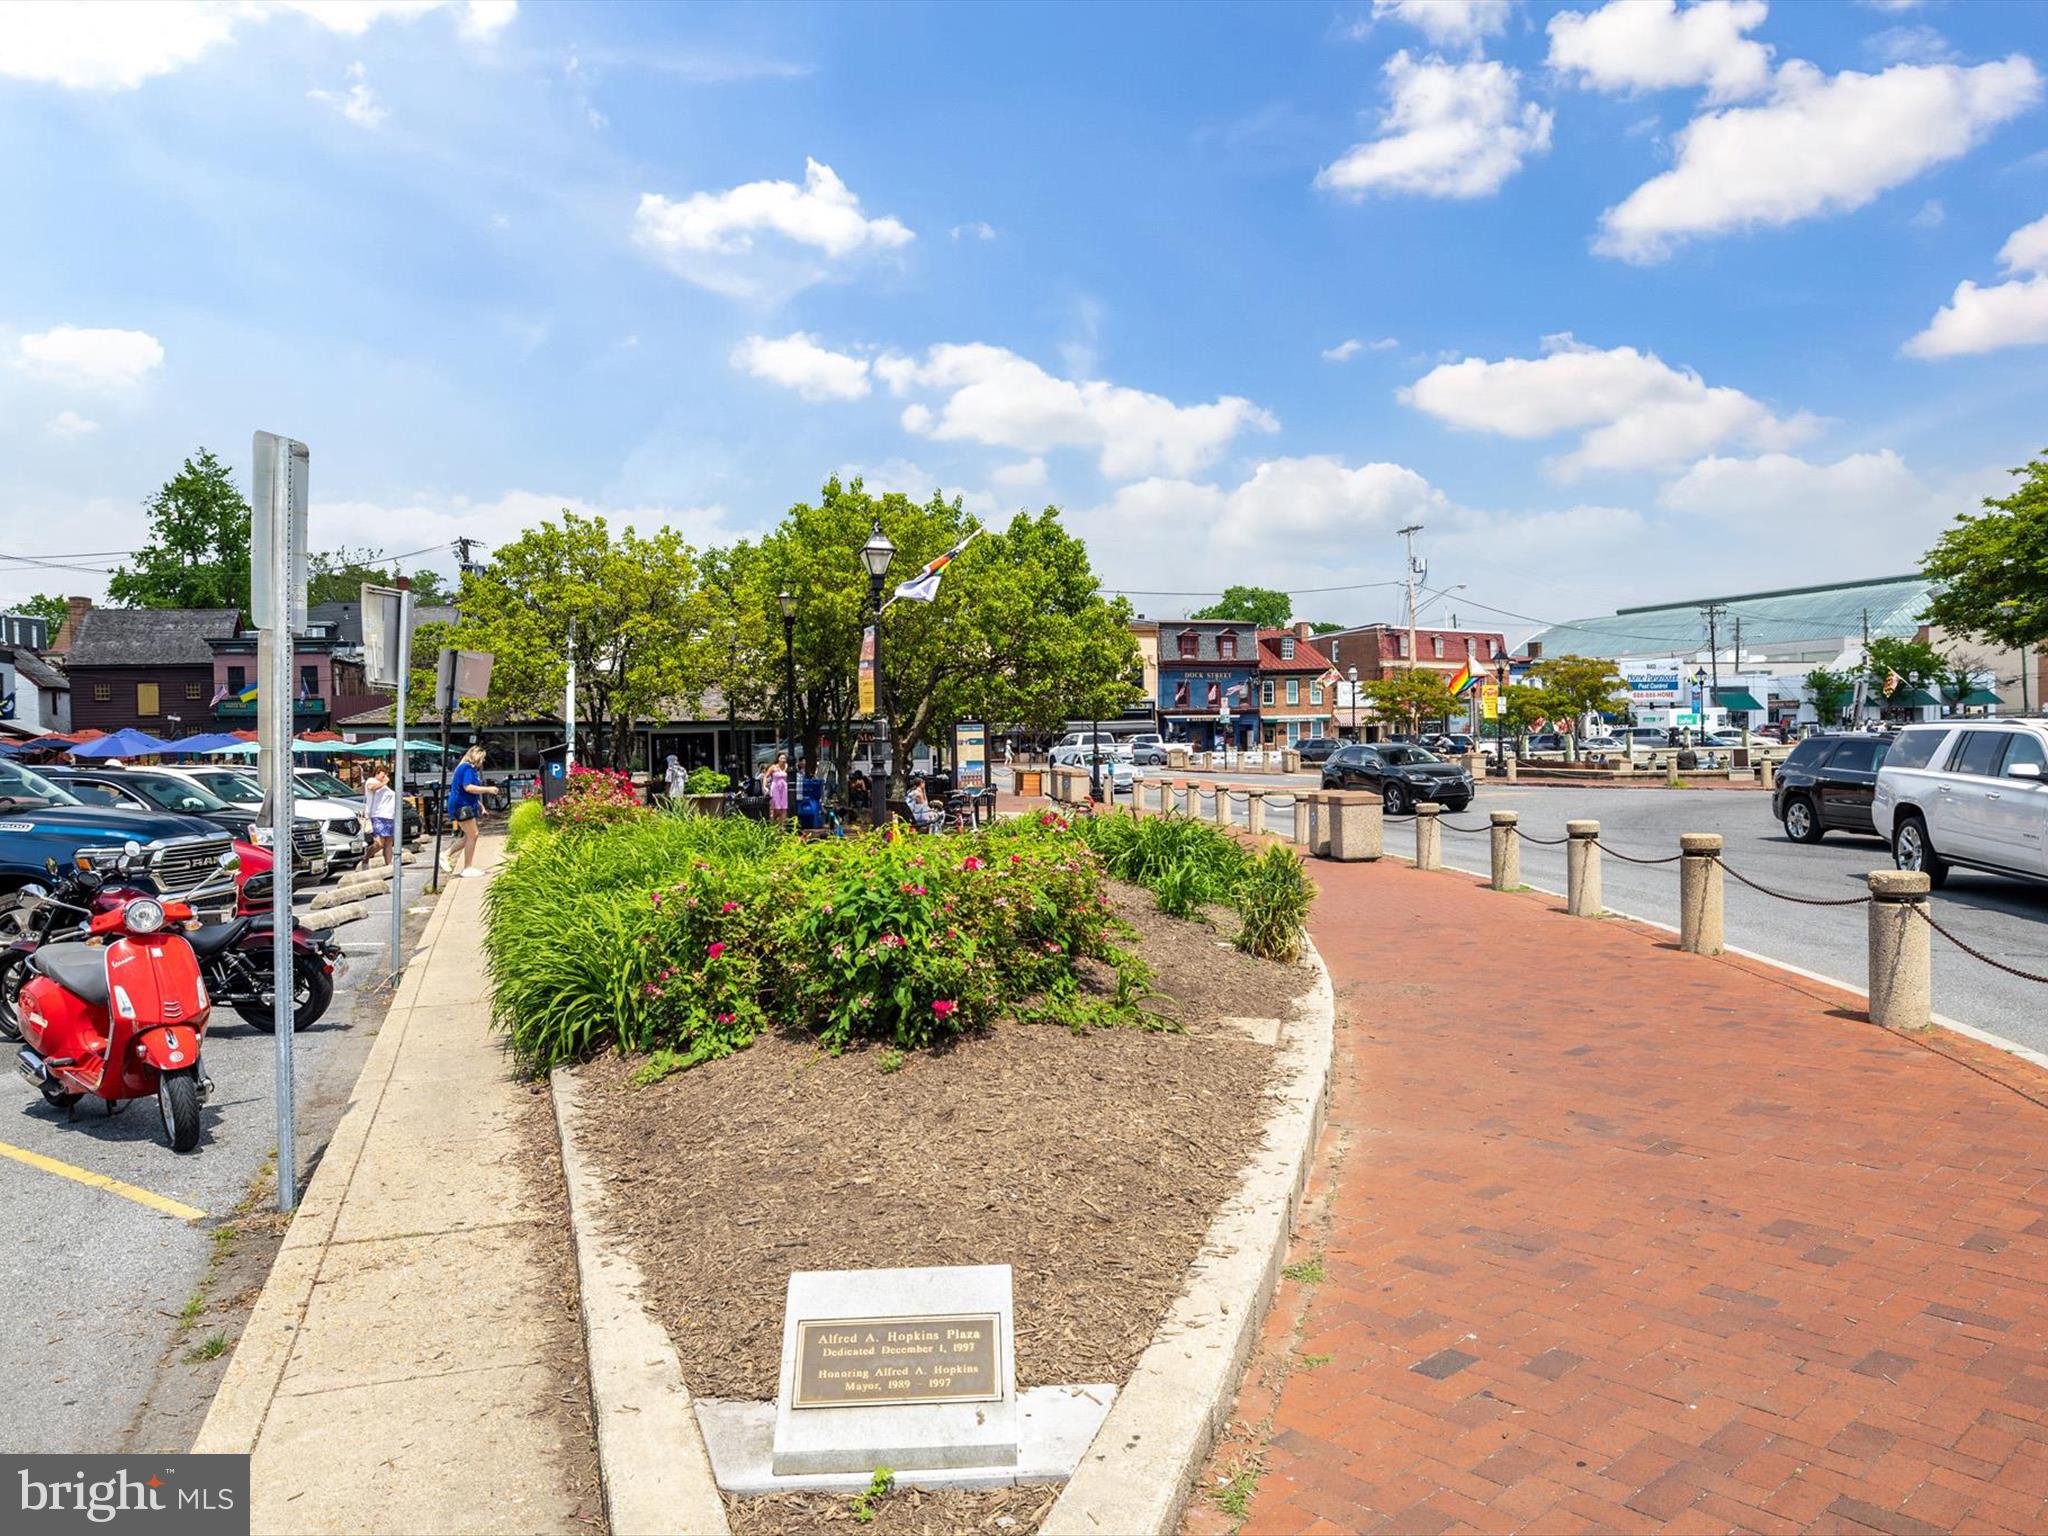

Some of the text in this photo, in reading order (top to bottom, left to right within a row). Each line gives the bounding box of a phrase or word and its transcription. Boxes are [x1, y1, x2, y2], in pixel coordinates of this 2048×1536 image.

[1627, 673, 1678, 682] Home Paramount
[552, 763, 561, 776] P
[817, 1329, 981, 1345] Alfred A. Hopkins Plaza
[823, 1342, 975, 1358] Dedicated December 1, 1997
[818, 1364, 979, 1379] Honoring Alfred A. Hopkins
[845, 1381, 882, 1392] Mayor,
[888, 1380, 910, 1389] 1989
[929, 1378, 951, 1388] 1997
